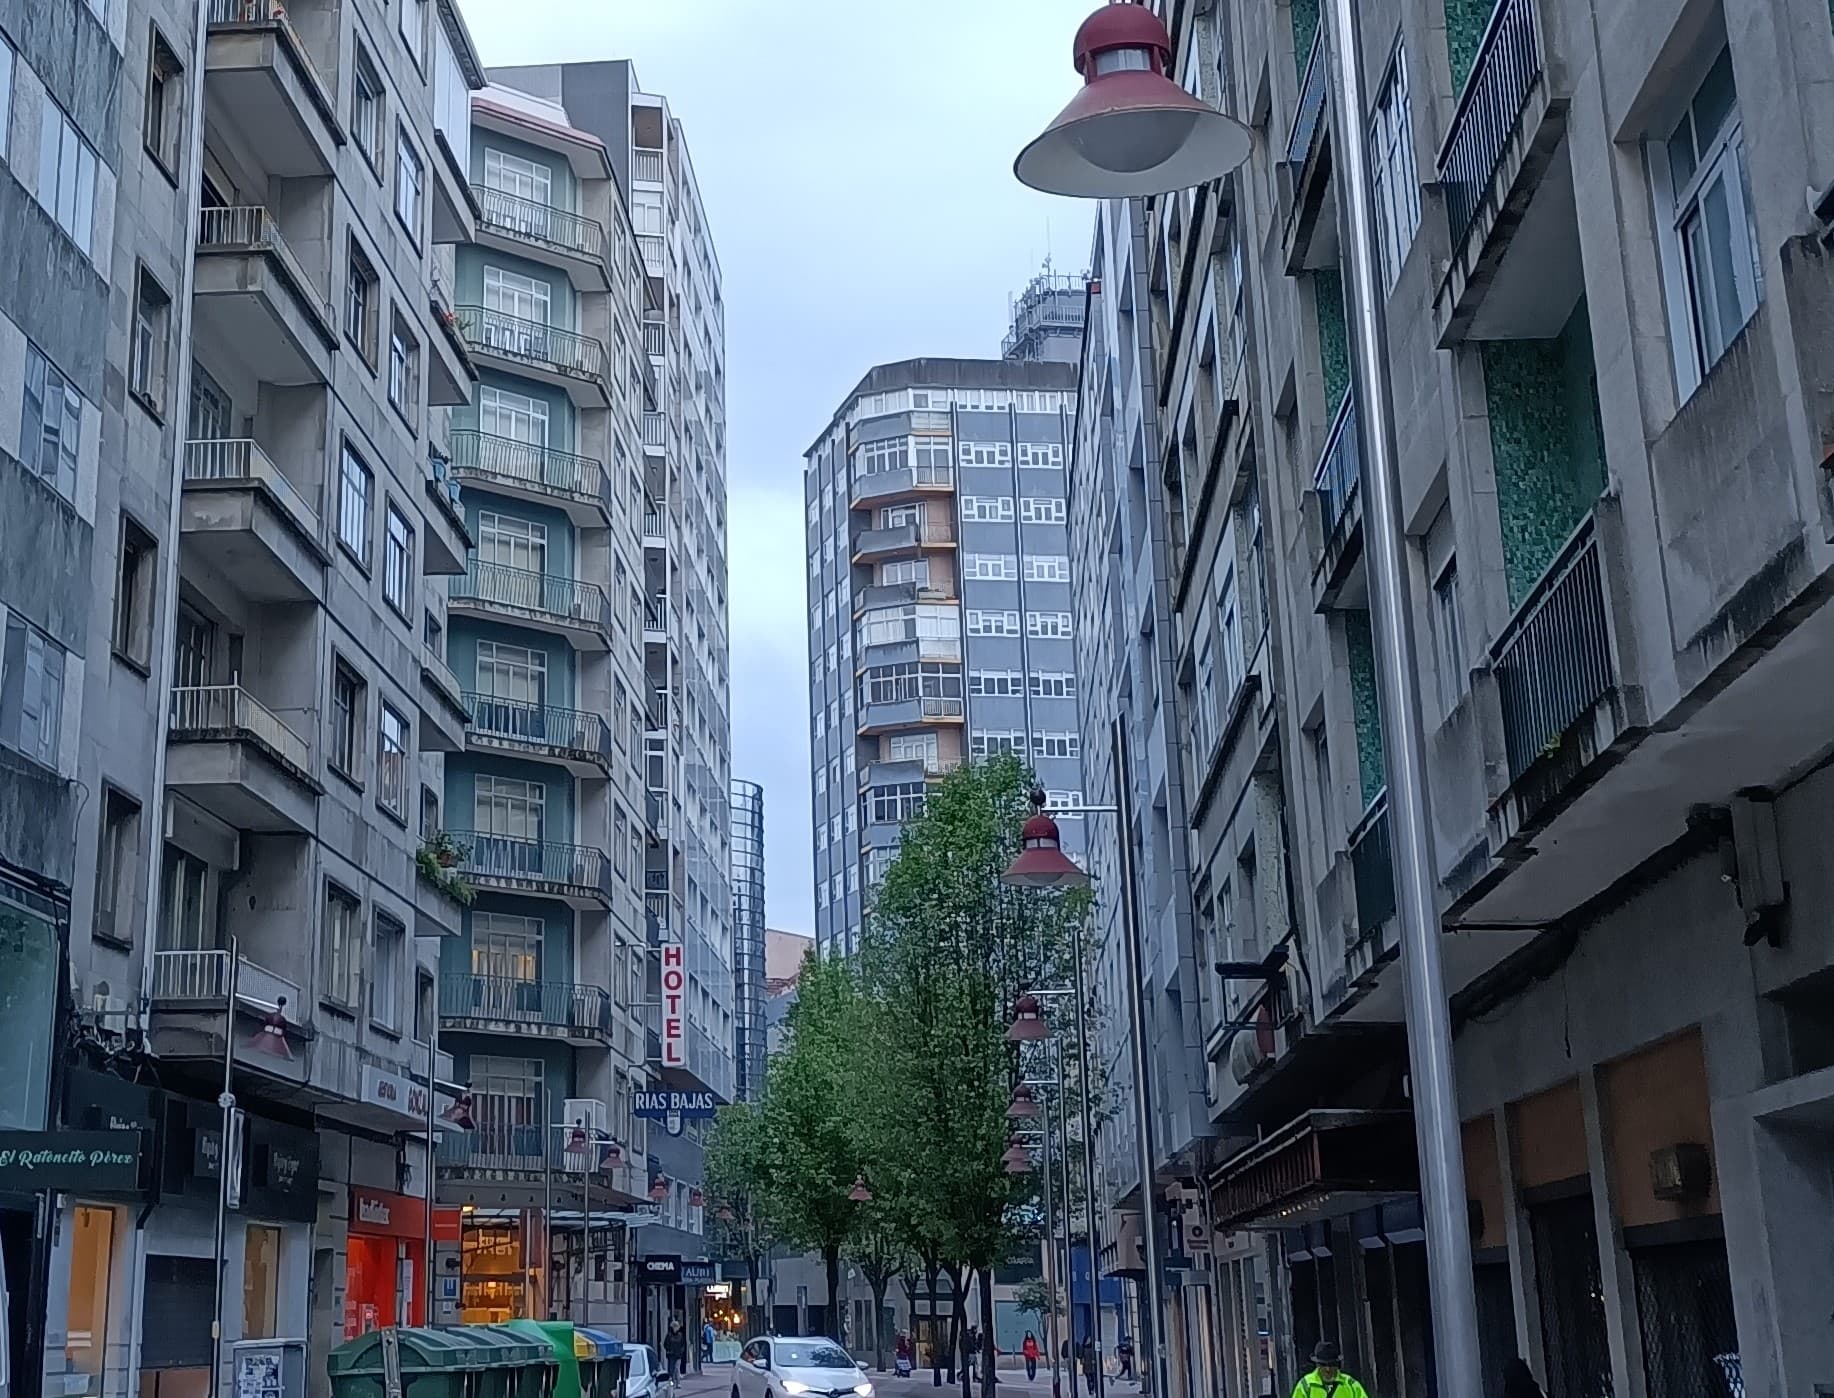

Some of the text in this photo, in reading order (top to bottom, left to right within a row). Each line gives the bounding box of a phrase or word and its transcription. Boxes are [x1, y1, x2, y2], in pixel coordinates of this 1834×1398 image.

[664, 946, 682, 1062] HOTEL
[635, 1092, 713, 1110] RIAS BAJAS
